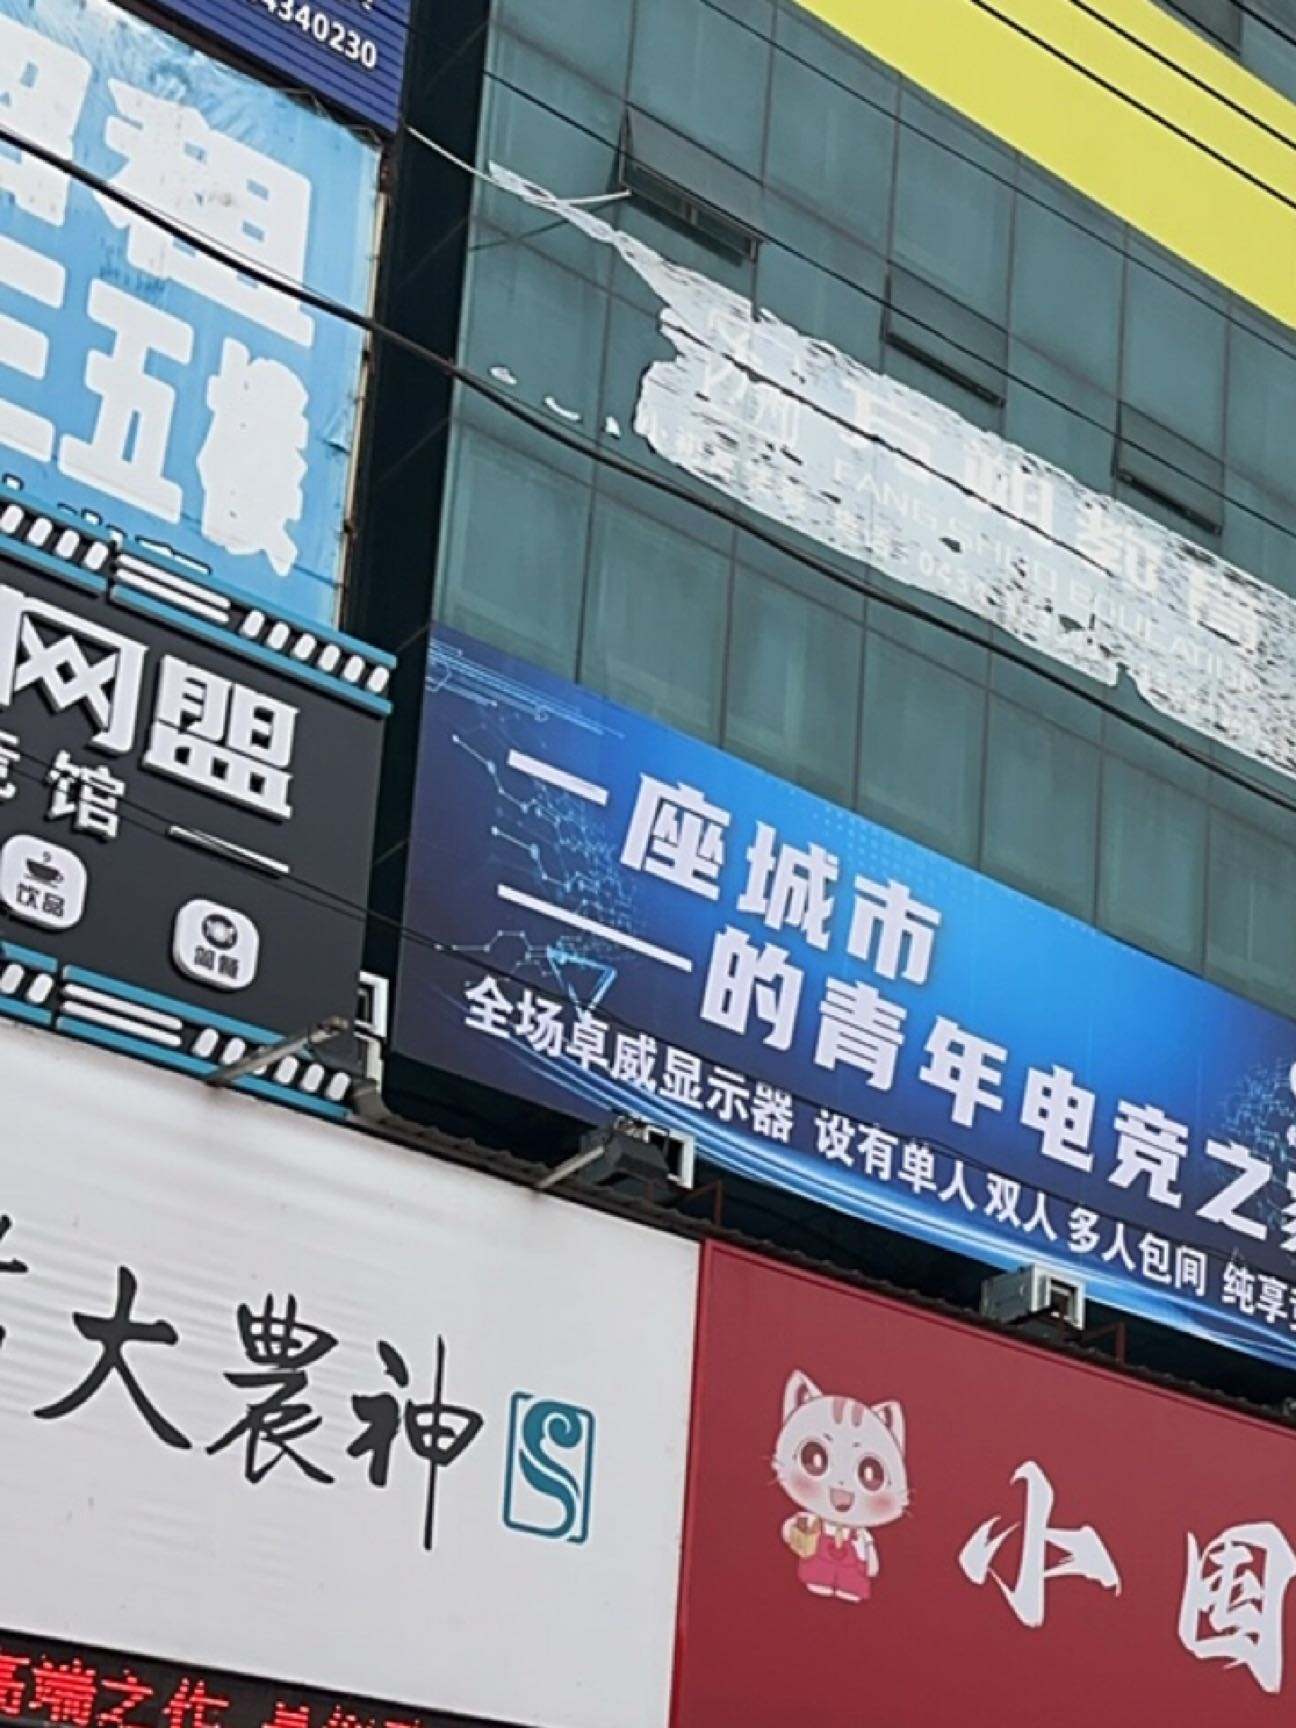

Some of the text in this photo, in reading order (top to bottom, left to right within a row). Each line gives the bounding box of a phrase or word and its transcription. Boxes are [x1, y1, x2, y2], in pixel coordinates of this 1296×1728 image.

[16, 882, 65, 917] 饮品
[507, 749, 941, 985] 一座城市
[465, 976, 795, 1144] 全场卓威显示器
[0, 1212, 484, 1551] 大農神
